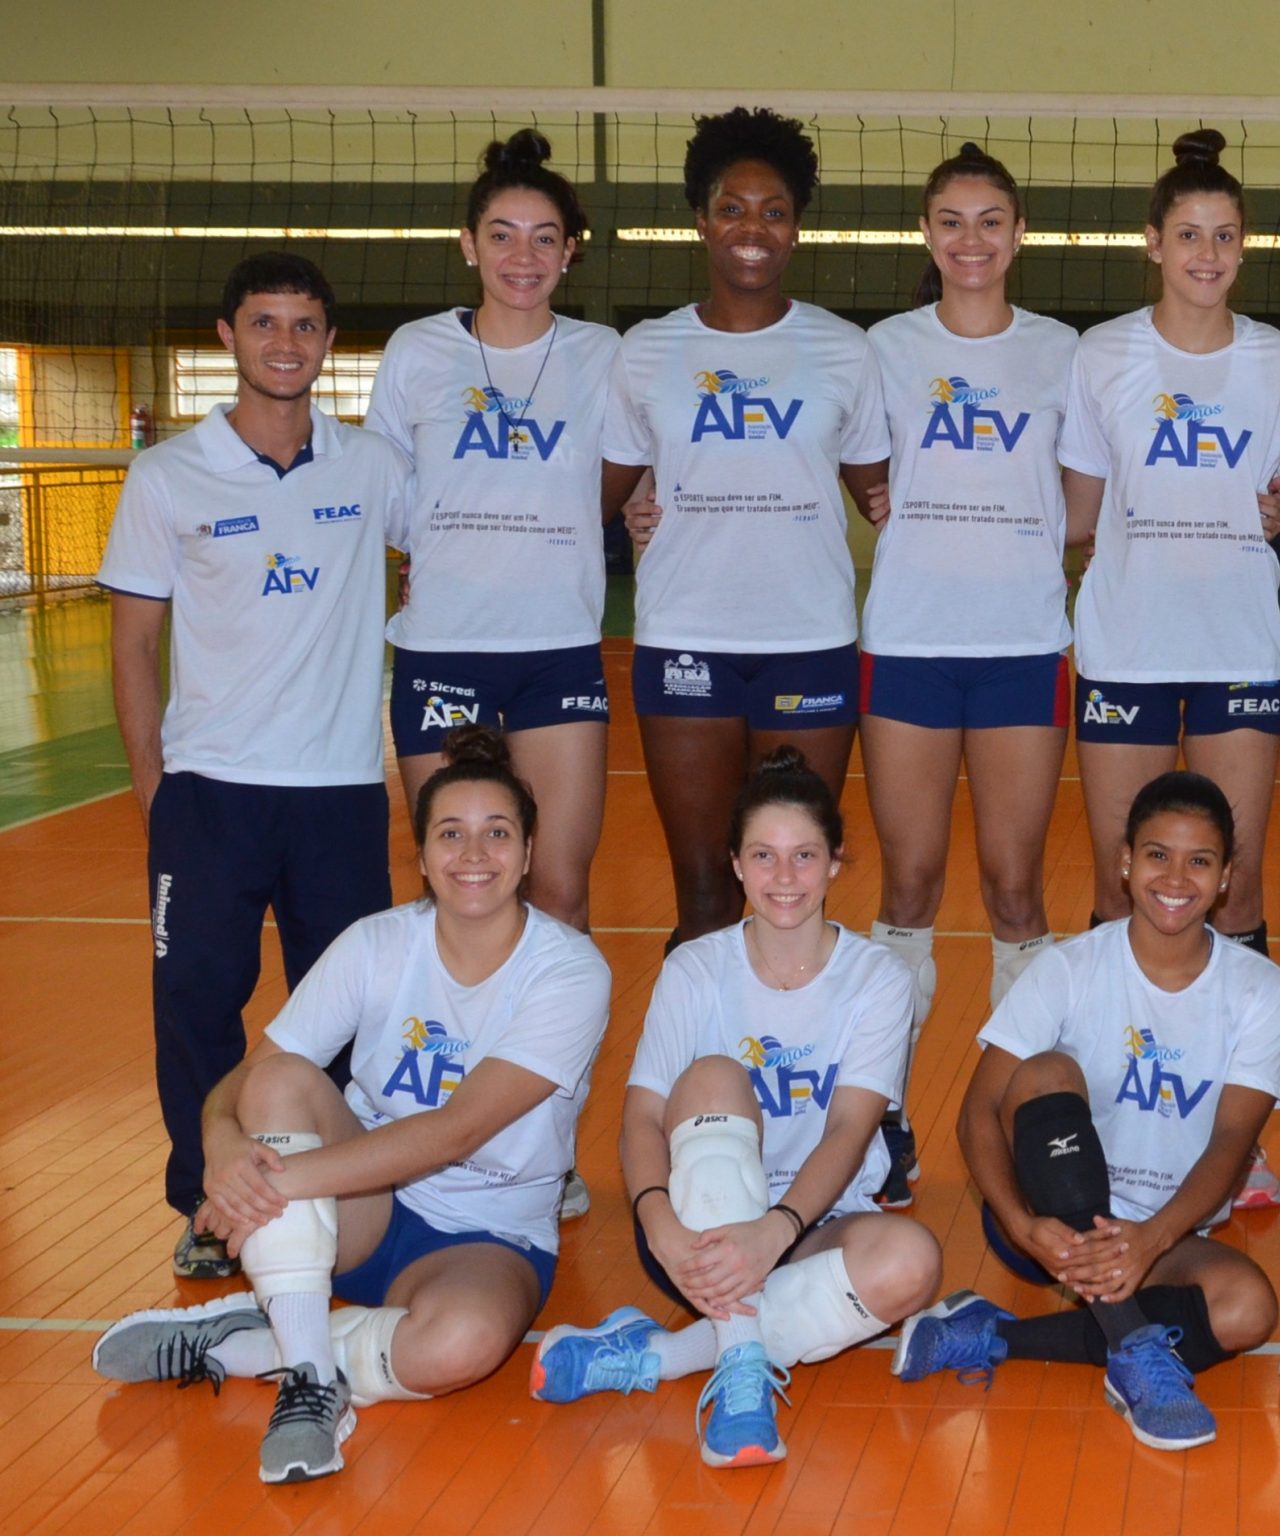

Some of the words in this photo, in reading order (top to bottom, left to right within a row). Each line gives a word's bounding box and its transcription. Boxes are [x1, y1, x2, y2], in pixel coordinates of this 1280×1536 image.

[453, 410, 566, 461] AFV
[691, 392, 804, 443] AFV
[920, 401, 1031, 452] AFV
[1145, 417, 1252, 469] AFV
[312, 504, 361, 520] FEAC
[262, 567, 320, 596] AFV
[429, 681, 476, 697] Sicredi
[562, 696, 608, 711] FEAC
[1228, 698, 1280, 713] FEAC
[420, 703, 479, 731] AFV
[1084, 702, 1139, 725] AFV
[156, 874, 172, 936] Unimed
[748, 1062, 838, 1118] AFV
[1115, 1054, 1213, 1119] AFV
